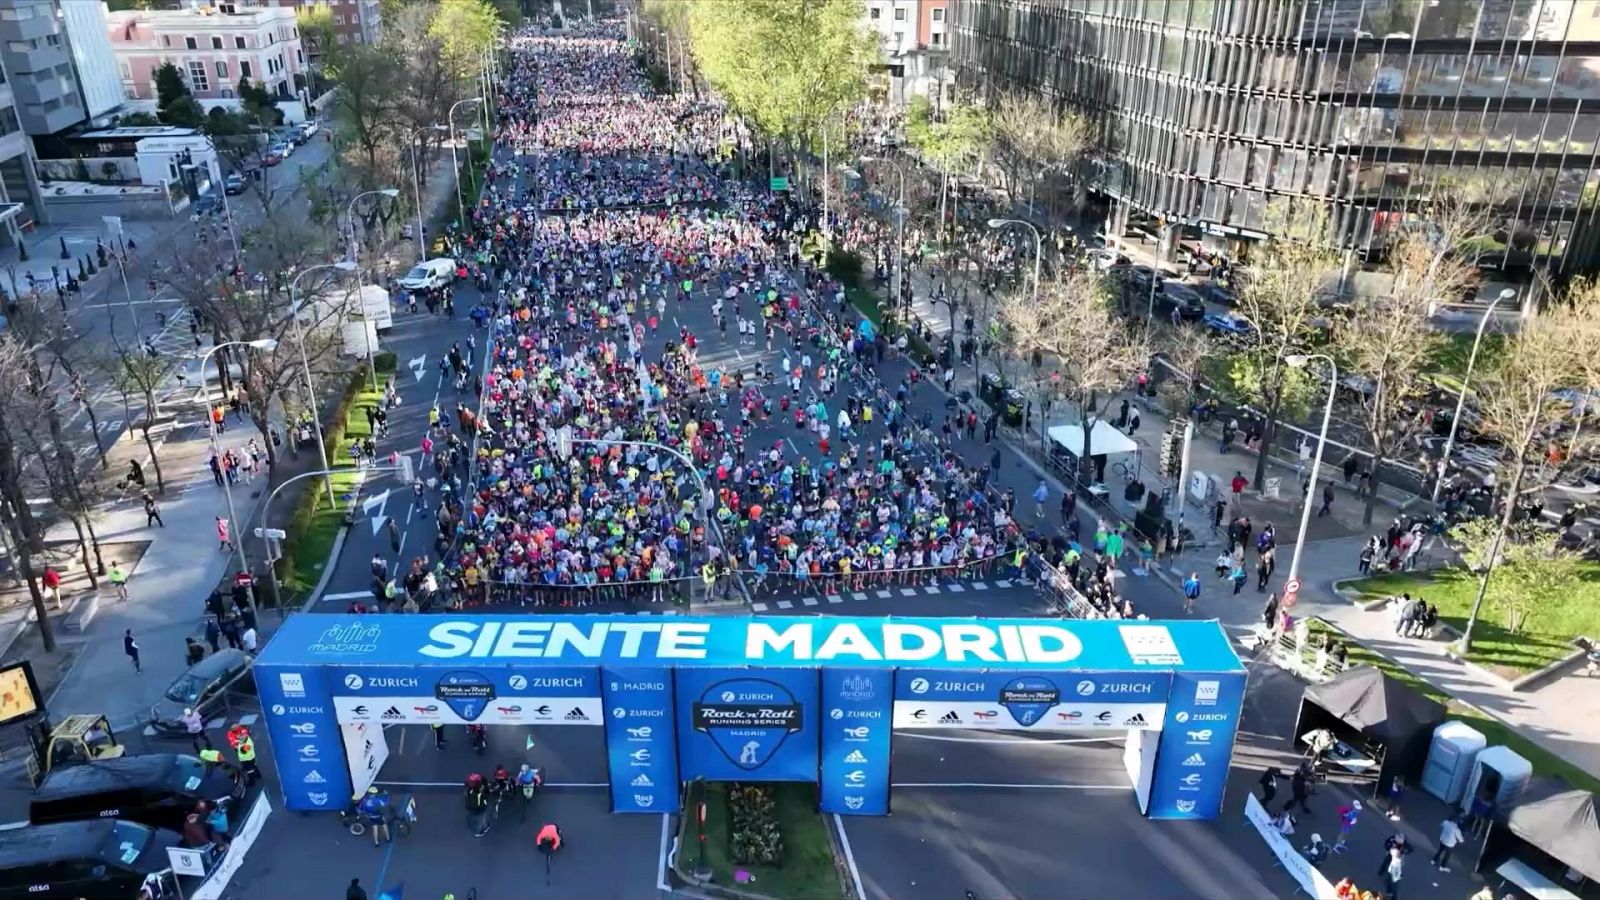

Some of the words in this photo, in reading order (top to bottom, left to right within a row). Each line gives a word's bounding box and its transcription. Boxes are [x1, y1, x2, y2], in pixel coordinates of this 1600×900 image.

[307, 643, 377, 652] MADRID
[418, 622, 710, 658] SIENTE
[745, 623, 1083, 664] MADRID
[369, 677, 418, 688] ZURICH
[533, 678, 583, 688] ZURICH
[624, 682, 664, 691] MADRID
[934, 682, 985, 692] ZURICH
[1101, 683, 1151, 693] ZURICH
[738, 693, 774, 701] ZURICH
[289, 706, 323, 714] ZURICH
[629, 709, 664, 717] ZURICH
[1192, 713, 1228, 721] ZURICH
[99, 808, 120, 817] alsa
[29, 883, 50, 893] alsa
